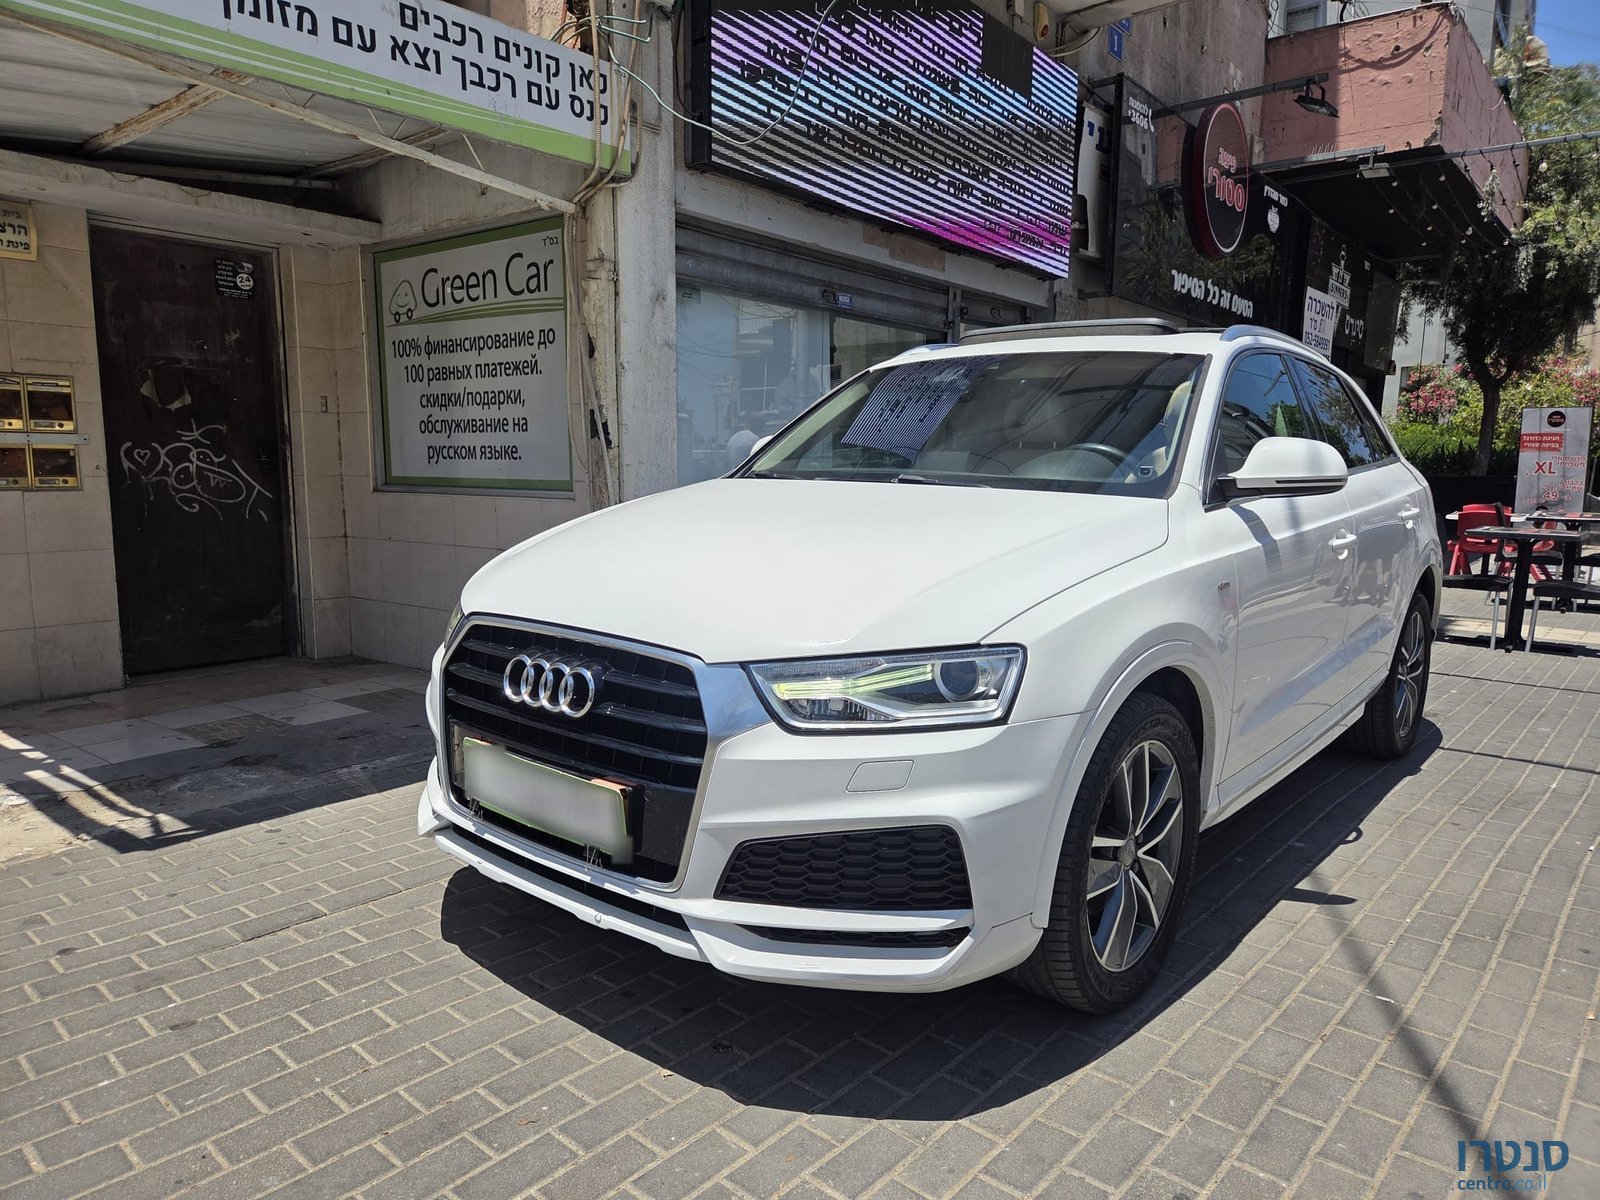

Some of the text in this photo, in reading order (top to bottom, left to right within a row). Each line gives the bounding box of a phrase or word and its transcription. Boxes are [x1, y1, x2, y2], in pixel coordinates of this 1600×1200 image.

[332, 16, 376, 53] עם
[400, 2, 607, 95] כאן קונים רכבים
[389, 34, 441, 76] וצא
[452, 55, 517, 98] רכבך
[527, 80, 560, 110] עם
[1207, 166, 1245, 212] סטורי
[421, 252, 554, 307] Green Car
[1171, 269, 1206, 301] הסיפור
[1206, 278, 1220, 305] כל
[1306, 295, 1335, 321] להשכרה
[391, 328, 556, 360] 100% финансирование до
[404, 354, 542, 387] 100 равных платежей.
[419, 387, 526, 412] скидки/подарки,
[419, 414, 528, 438] обслуживание на
[427, 443, 522, 465] русском языке.
[1534, 461, 1556, 475] XL
[1543, 491, 1558, 500] 49
